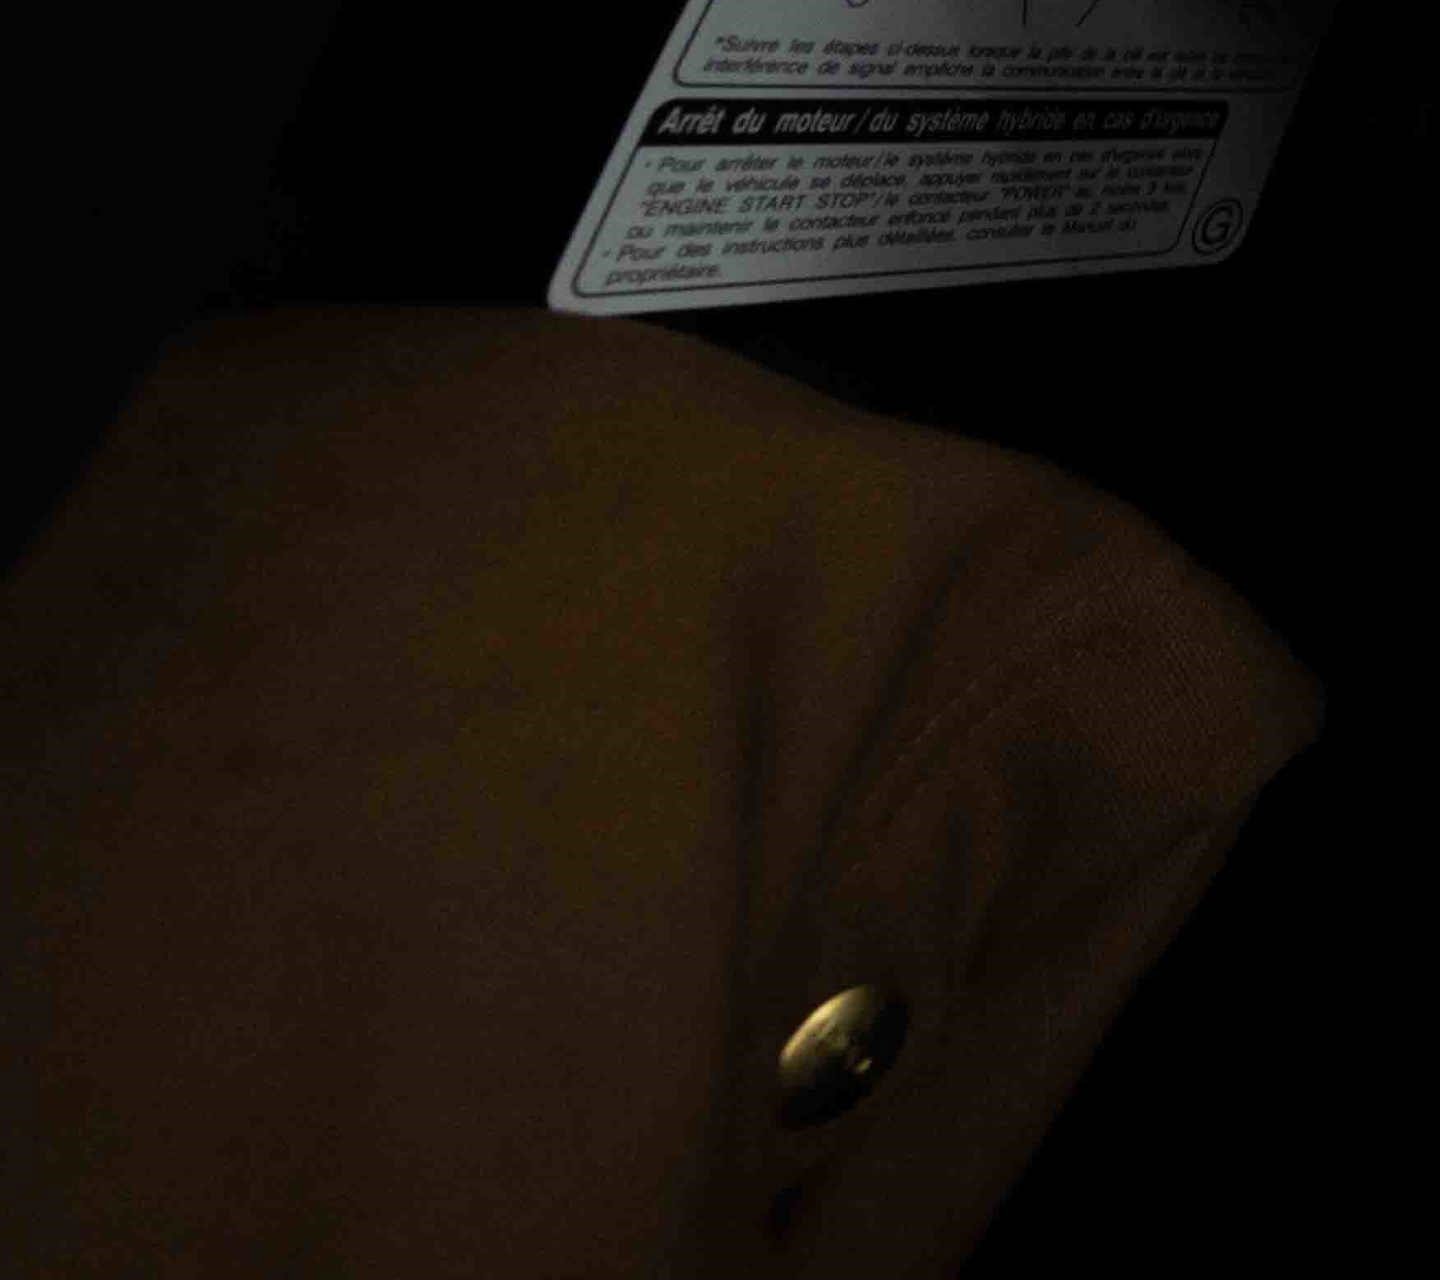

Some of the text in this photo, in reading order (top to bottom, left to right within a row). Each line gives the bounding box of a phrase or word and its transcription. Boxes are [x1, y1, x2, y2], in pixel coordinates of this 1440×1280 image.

[657, 103, 729, 136] Arrêt
[731, 105, 768, 136] du
[739, 193, 807, 214] START
